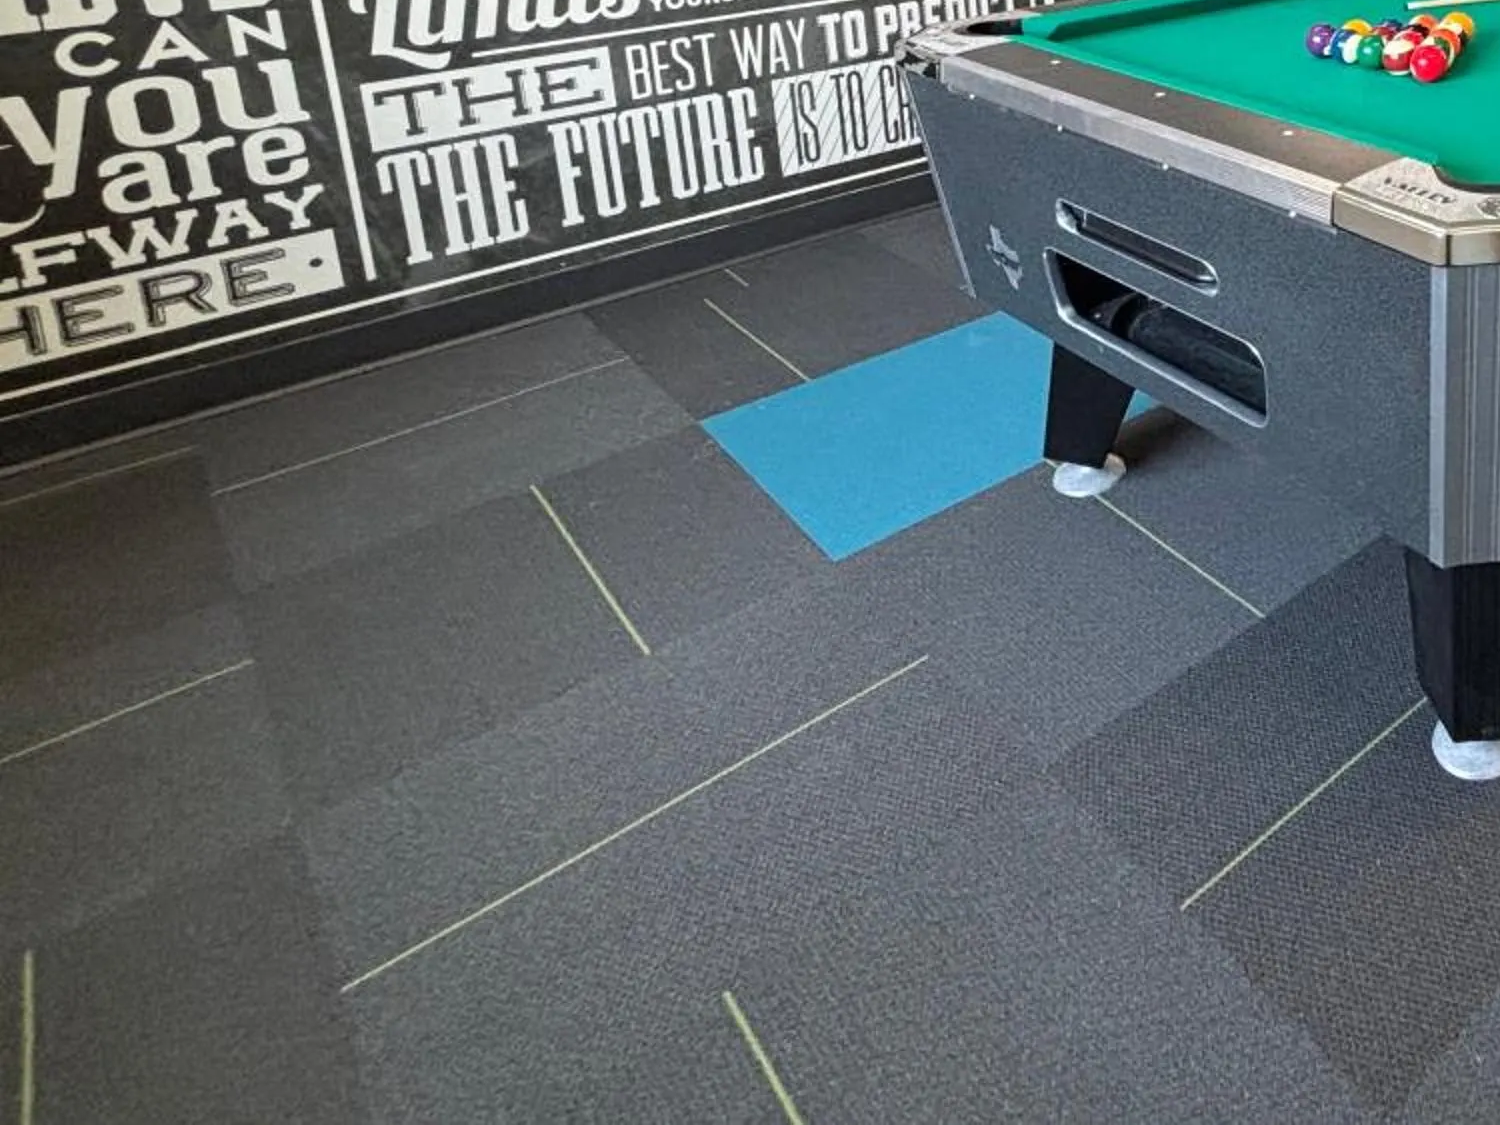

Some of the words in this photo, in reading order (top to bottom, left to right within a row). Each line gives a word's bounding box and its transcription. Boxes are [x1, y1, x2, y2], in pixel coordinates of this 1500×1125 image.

[54, 9, 288, 77] CAN
[373, 57, 606, 137] THE
[624, 32, 717, 101] BEST
[729, 17, 806, 80] WAY
[815, 8, 868, 64] TO
[0, 59, 311, 201] you
[97, 127, 311, 215] are
[376, 133, 530, 265] THE
[547, 86, 765, 228] FUTURE
[788, 79, 821, 166] IS
[830, 71, 869, 156] TO
